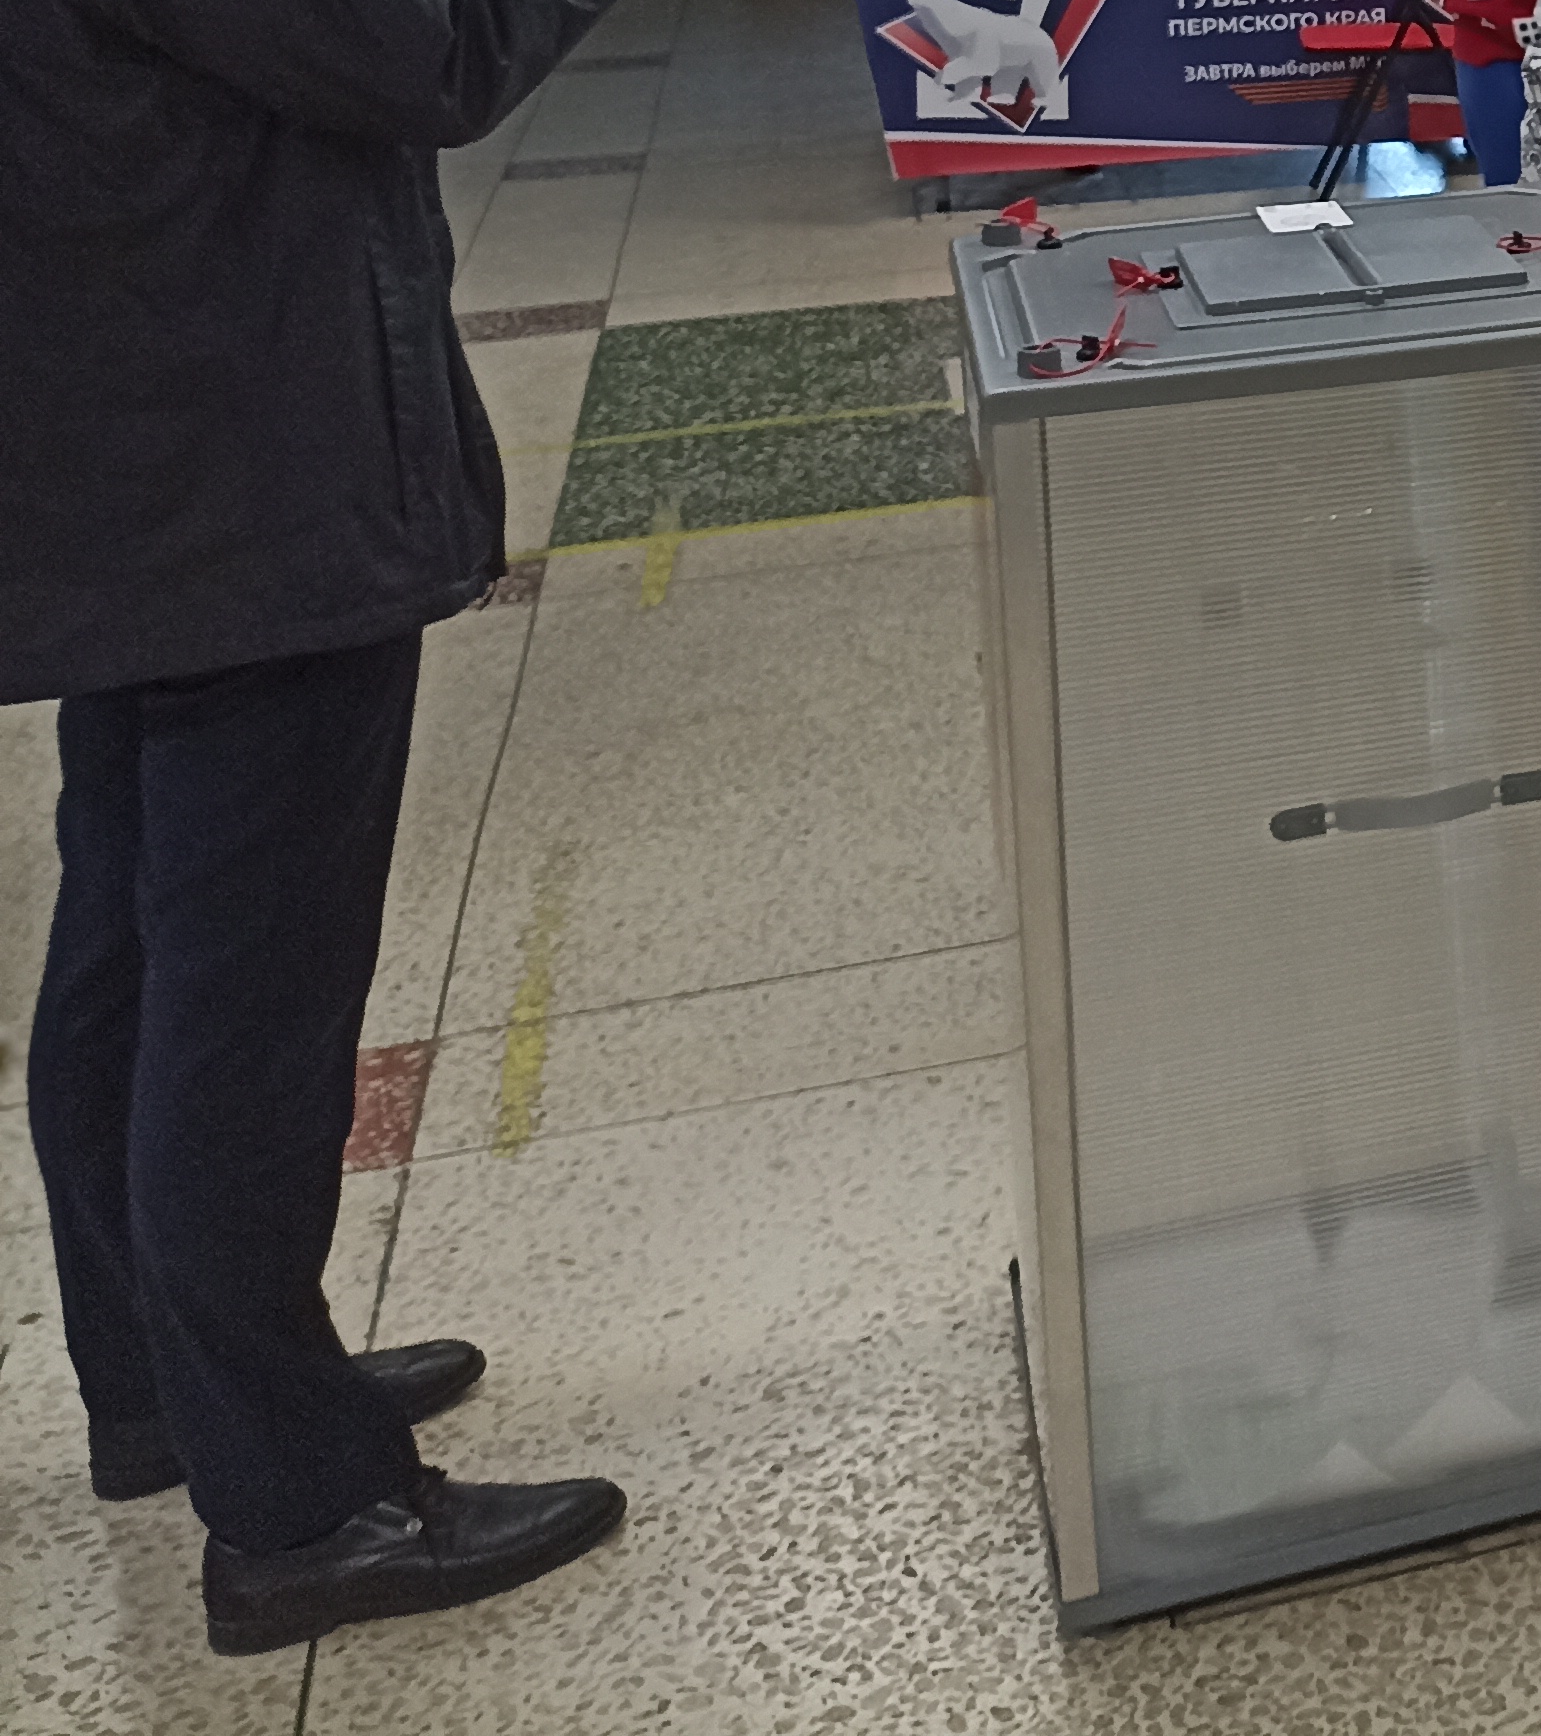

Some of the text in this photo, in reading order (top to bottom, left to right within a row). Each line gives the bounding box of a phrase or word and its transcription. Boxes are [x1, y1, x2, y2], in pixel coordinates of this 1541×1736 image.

[1167, 7, 1386, 37] ПЕРМСКОГО КРАЯ
[1184, 62, 1256, 83] ЗАВТРА
[1259, 59, 1345, 79] выберем
